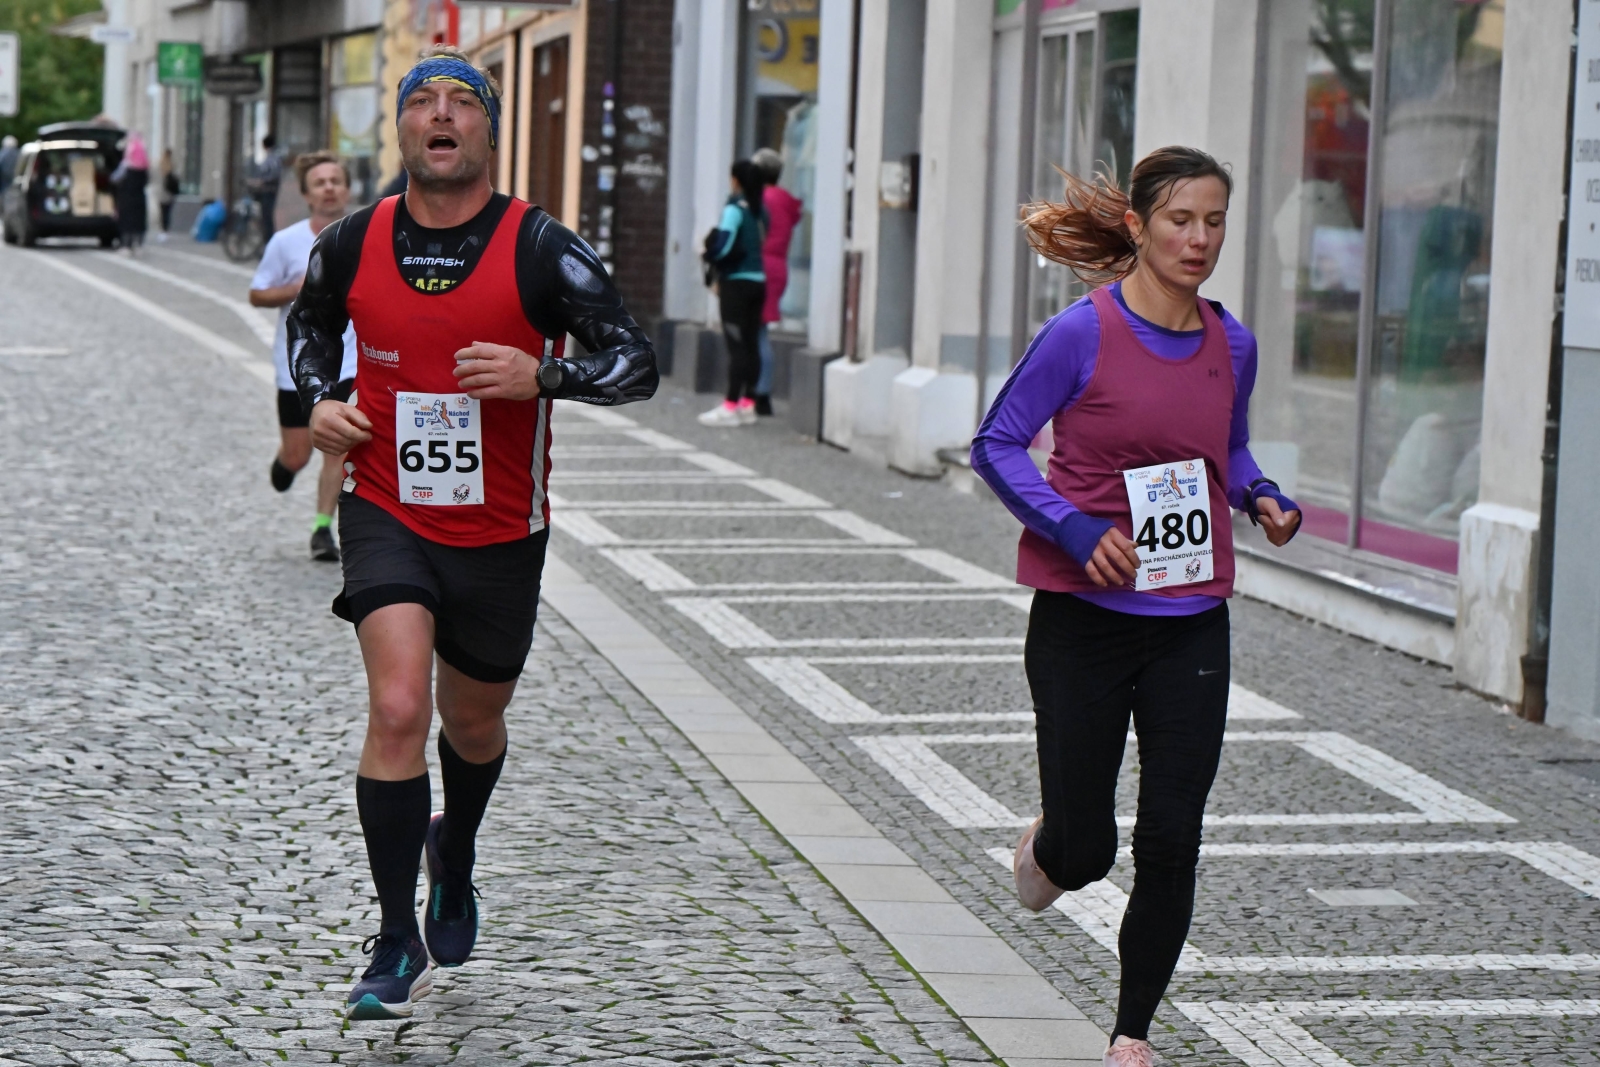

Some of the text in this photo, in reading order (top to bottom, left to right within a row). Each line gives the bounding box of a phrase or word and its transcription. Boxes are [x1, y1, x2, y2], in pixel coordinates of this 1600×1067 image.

[402, 256, 465, 267] SMMASH
[566, 396, 614, 404] MMASH
[399, 439, 480, 473] 655
[1145, 477, 1198, 490] Hronov Náchod
[412, 490, 434, 499] CUP
[1136, 509, 1209, 553] 480
[1153, 551, 1193, 563] PROCHÁZKOVÁ
[1147, 571, 1168, 582] CUP
